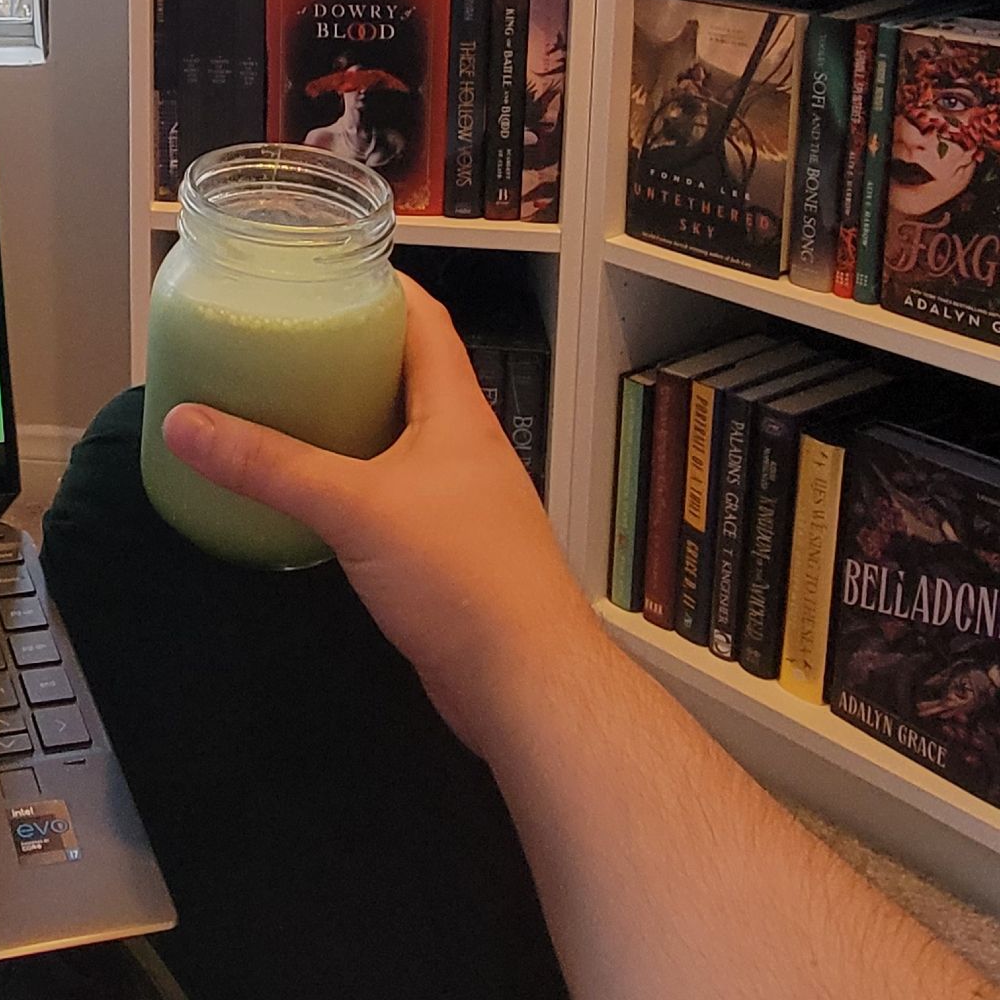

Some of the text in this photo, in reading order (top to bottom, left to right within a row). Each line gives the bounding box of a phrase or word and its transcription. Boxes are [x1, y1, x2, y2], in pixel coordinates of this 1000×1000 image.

[314, 3, 398, 19] DOWRY
[316, 22, 395, 41] BLOOD
[458, 40, 476, 77] THESE
[497, 8, 516, 139] KING BATTLE BLOOD
[811, 71, 828, 109] SOFI
[457, 81, 475, 142] HOLLOW
[811, 112, 821, 140] AND
[455, 144, 473, 187] VOWS
[808, 143, 820, 164] THE
[649, 168, 751, 201] FONDA LEE
[803, 167, 821, 214] BONE
[633, 182, 770, 231] UNTETHERED
[679, 218, 715, 239] SKY
[800, 215, 817, 264] SONG
[904, 294, 980, 328] ADALYN
[691, 394, 709, 455] PORTRAIT
[691, 455, 705, 472] OF
[811, 478, 829, 505] LIES
[723, 491, 740, 540] GRACE
[683, 538, 700, 578] GRACE
[716, 558, 734, 626] KINGFISHER
[838, 690, 948, 769] ADALYN GRACE
[16, 819, 70, 838] evo
